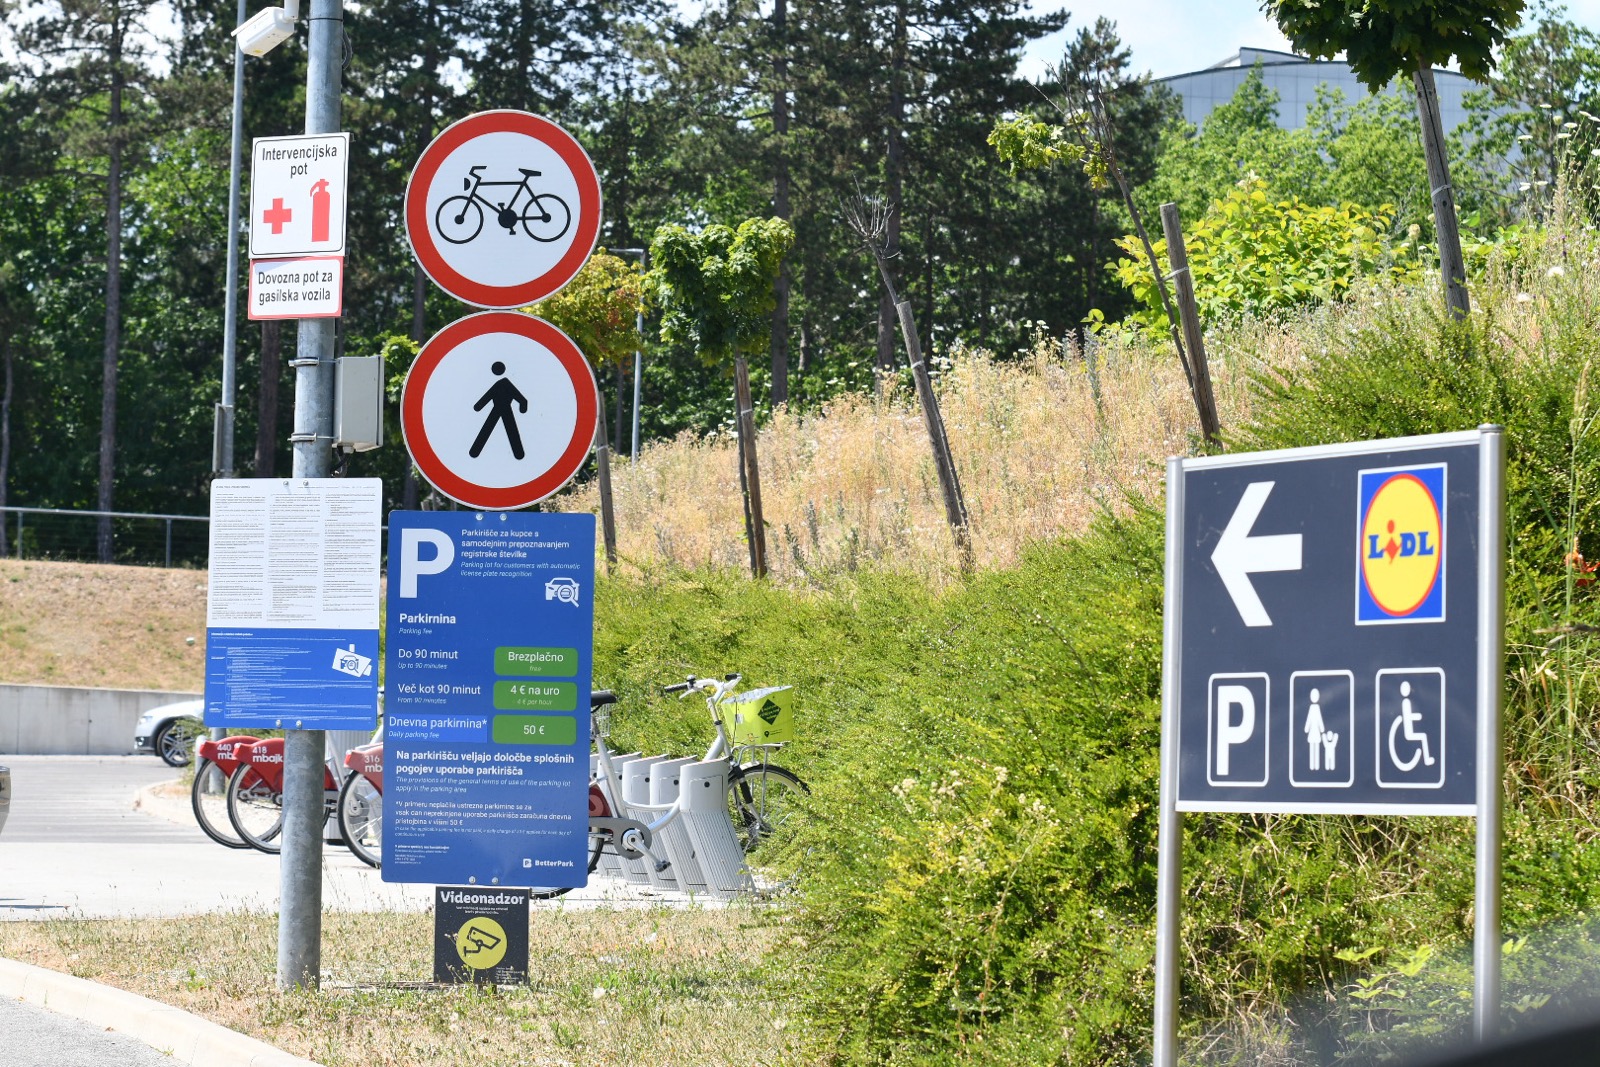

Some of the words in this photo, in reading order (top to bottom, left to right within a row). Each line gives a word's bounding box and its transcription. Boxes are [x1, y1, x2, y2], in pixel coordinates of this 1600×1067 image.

[262, 143, 338, 162] Intervencijska
[290, 163, 308, 179] pot
[258, 270, 301, 285] Dovozna
[302, 270, 319, 286] pot
[321, 272, 333, 282] za
[259, 289, 299, 306] gasilska
[301, 288, 331, 301] vozila
[461, 529, 498, 537] Parkirišče
[510, 530, 533, 538] kupce
[461, 540, 507, 549] samodejnim
[508, 541, 570, 550] prepoznavanjem
[461, 551, 498, 559] registrske
[499, 550, 527, 558] številke
[399, 528, 455, 598] P
[460, 561, 484, 569] Parking
[550, 562, 581, 570] automatic
[482, 571, 498, 579] plate
[498, 571, 533, 579] recognition
[399, 613, 457, 624] Parkirnina
[398, 627, 422, 635] Parking
[398, 649, 412, 659] Do
[414, 649, 428, 659] 90
[430, 649, 459, 660] minut
[508, 651, 564, 664] Brezplačno
[398, 662, 407, 670] Up
[398, 683, 417, 694] Več
[419, 685, 435, 694] kot
[437, 685, 450, 695] 90
[453, 685, 481, 695] minut
[510, 685, 517, 694] 4
[519, 686, 526, 694] €
[542, 688, 560, 696] uro
[389, 716, 428, 727] Dnevna
[523, 725, 536, 735] 50
[538, 726, 545, 735] €
[1216, 685, 1256, 777] P
[388, 731, 404, 739] Daily
[404, 732, 428, 740] parking
[216, 743, 232, 752] 440
[252, 746, 268, 754] 418
[364, 755, 380, 763] 316
[396, 750, 410, 760] Na
[411, 751, 459, 763] parkirišču
[461, 751, 492, 763] veljajo
[494, 752, 532, 763] določbe
[533, 753, 575, 765] splošnih
[395, 765, 434, 775] pogojev
[435, 765, 474, 776] uporabe
[476, 766, 523, 777] parkirišča
[538, 780, 562, 788] parking
[395, 785, 411, 793] apply
[430, 785, 453, 794] parking
[535, 859, 574, 868] BetterPark
[440, 890, 525, 905] Videonadzor
